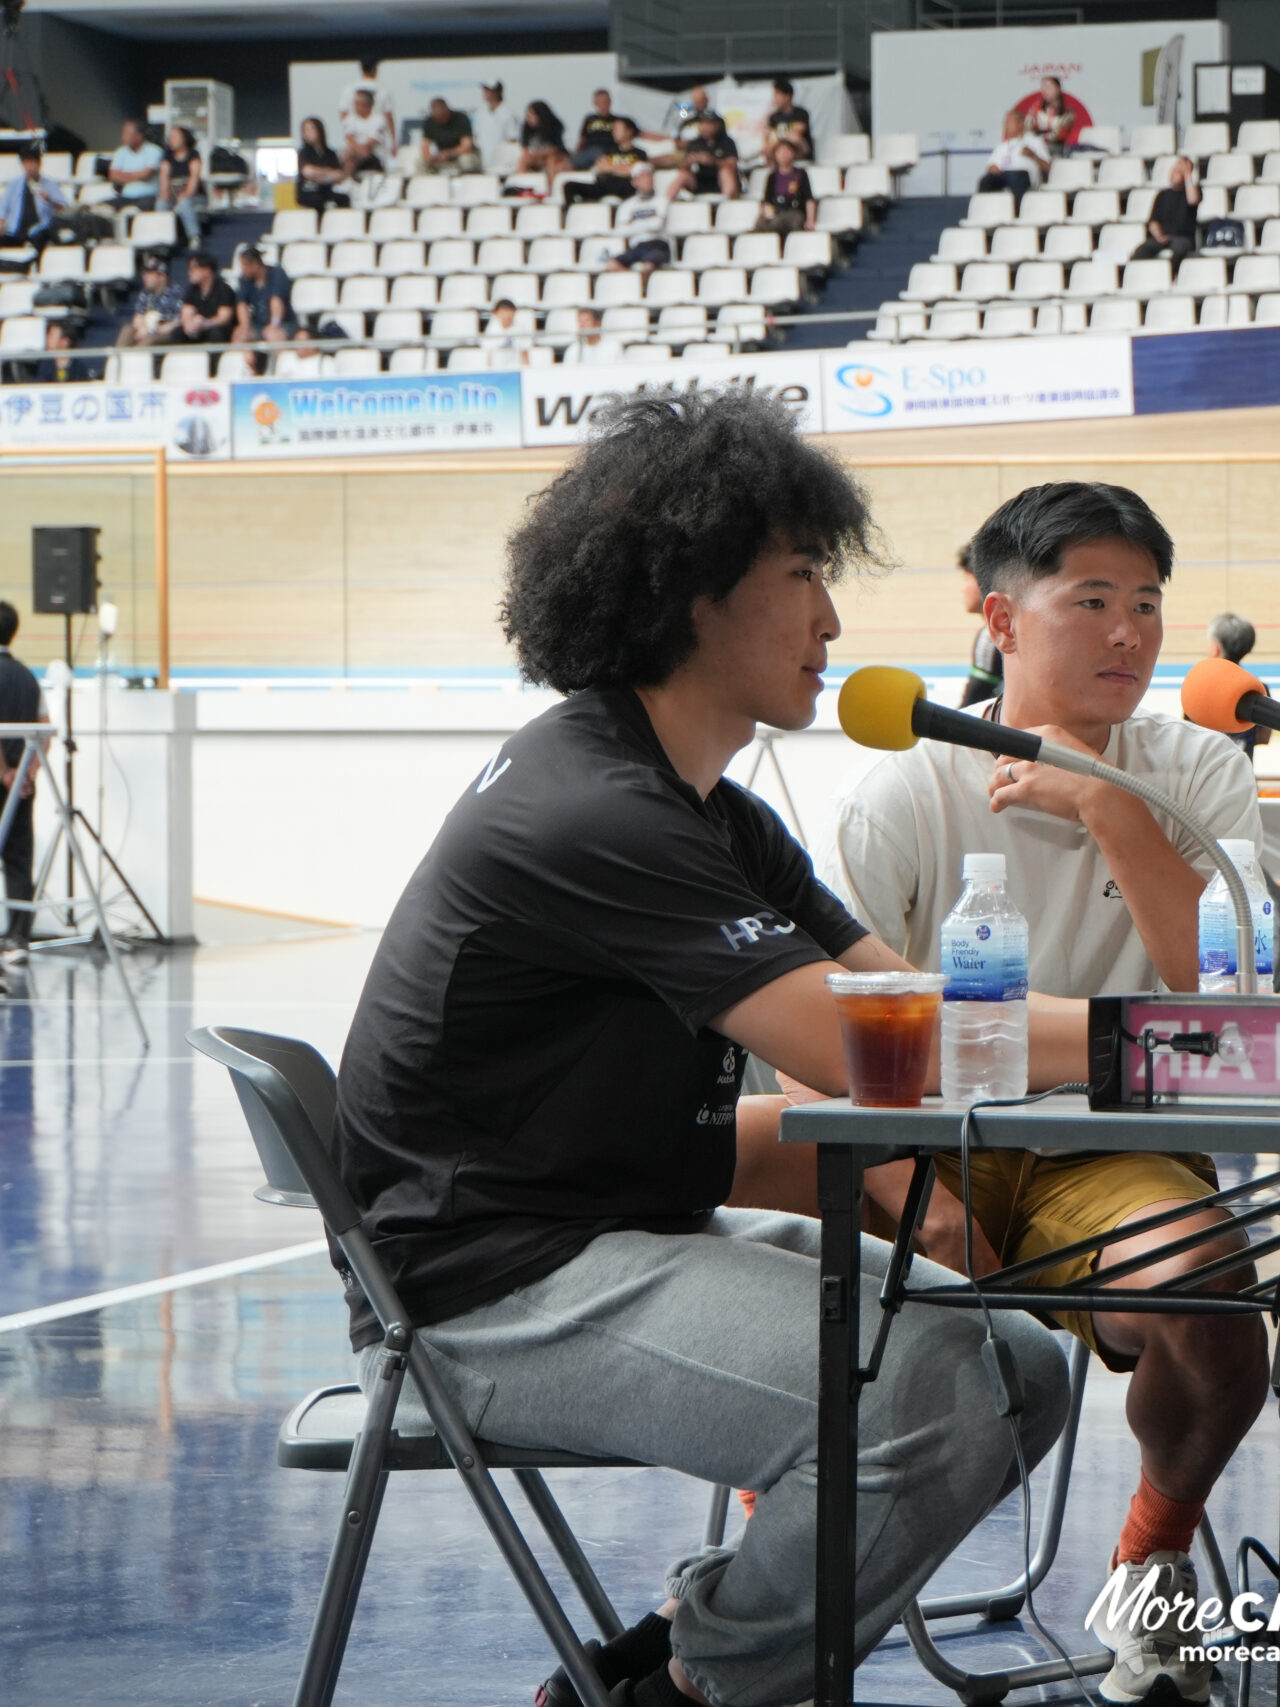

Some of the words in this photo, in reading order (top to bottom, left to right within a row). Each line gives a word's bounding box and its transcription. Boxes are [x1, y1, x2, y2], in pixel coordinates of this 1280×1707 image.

[1019, 63, 1082, 75] JAPAN
[901, 362, 986, 394] E-Spo
[4, 389, 168, 424] 伊豆の国市
[291, 387, 421, 417] Welcome
[428, 386, 456, 412] to
[951, 940, 969, 948] Body
[952, 956, 986, 969] Water
